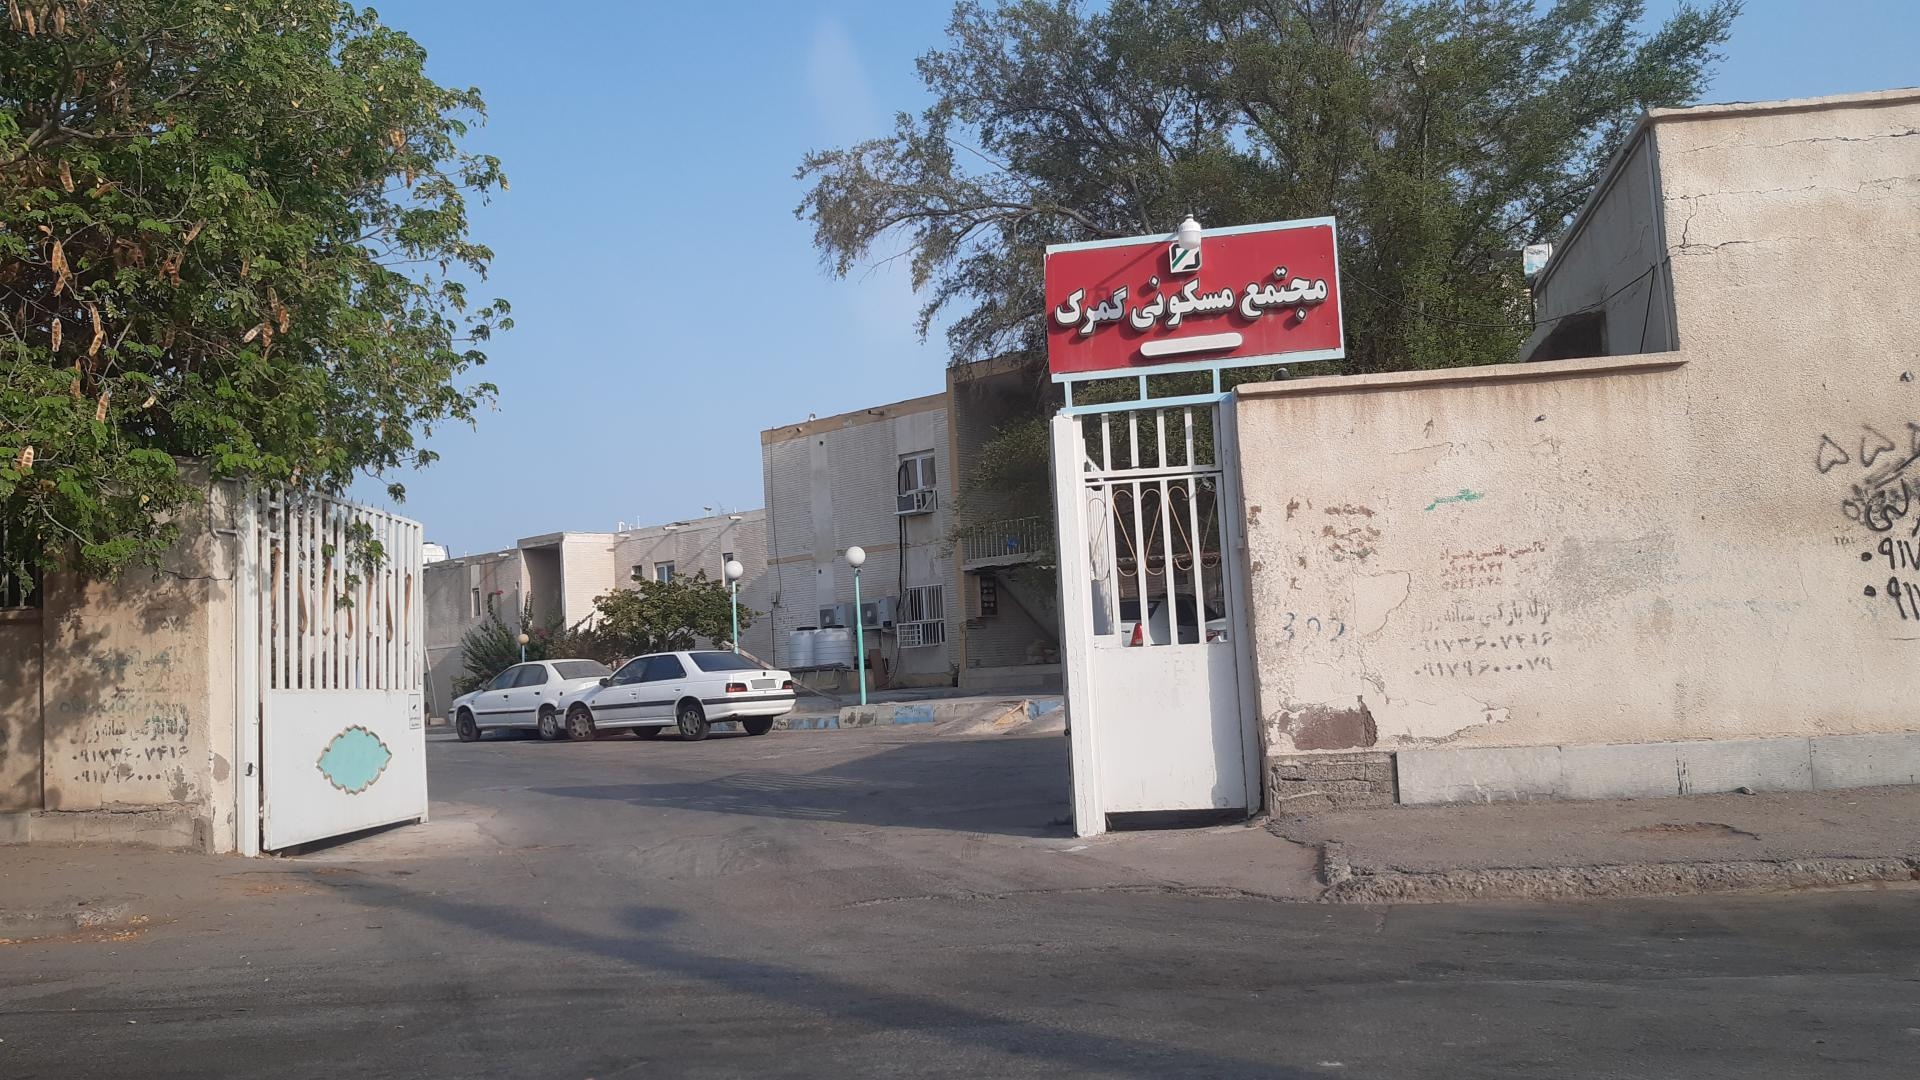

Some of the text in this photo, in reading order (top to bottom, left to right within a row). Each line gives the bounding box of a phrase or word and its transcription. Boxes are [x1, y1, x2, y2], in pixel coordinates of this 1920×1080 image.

[1055, 266, 1328, 335] مجتمع مسکونی گمرک
